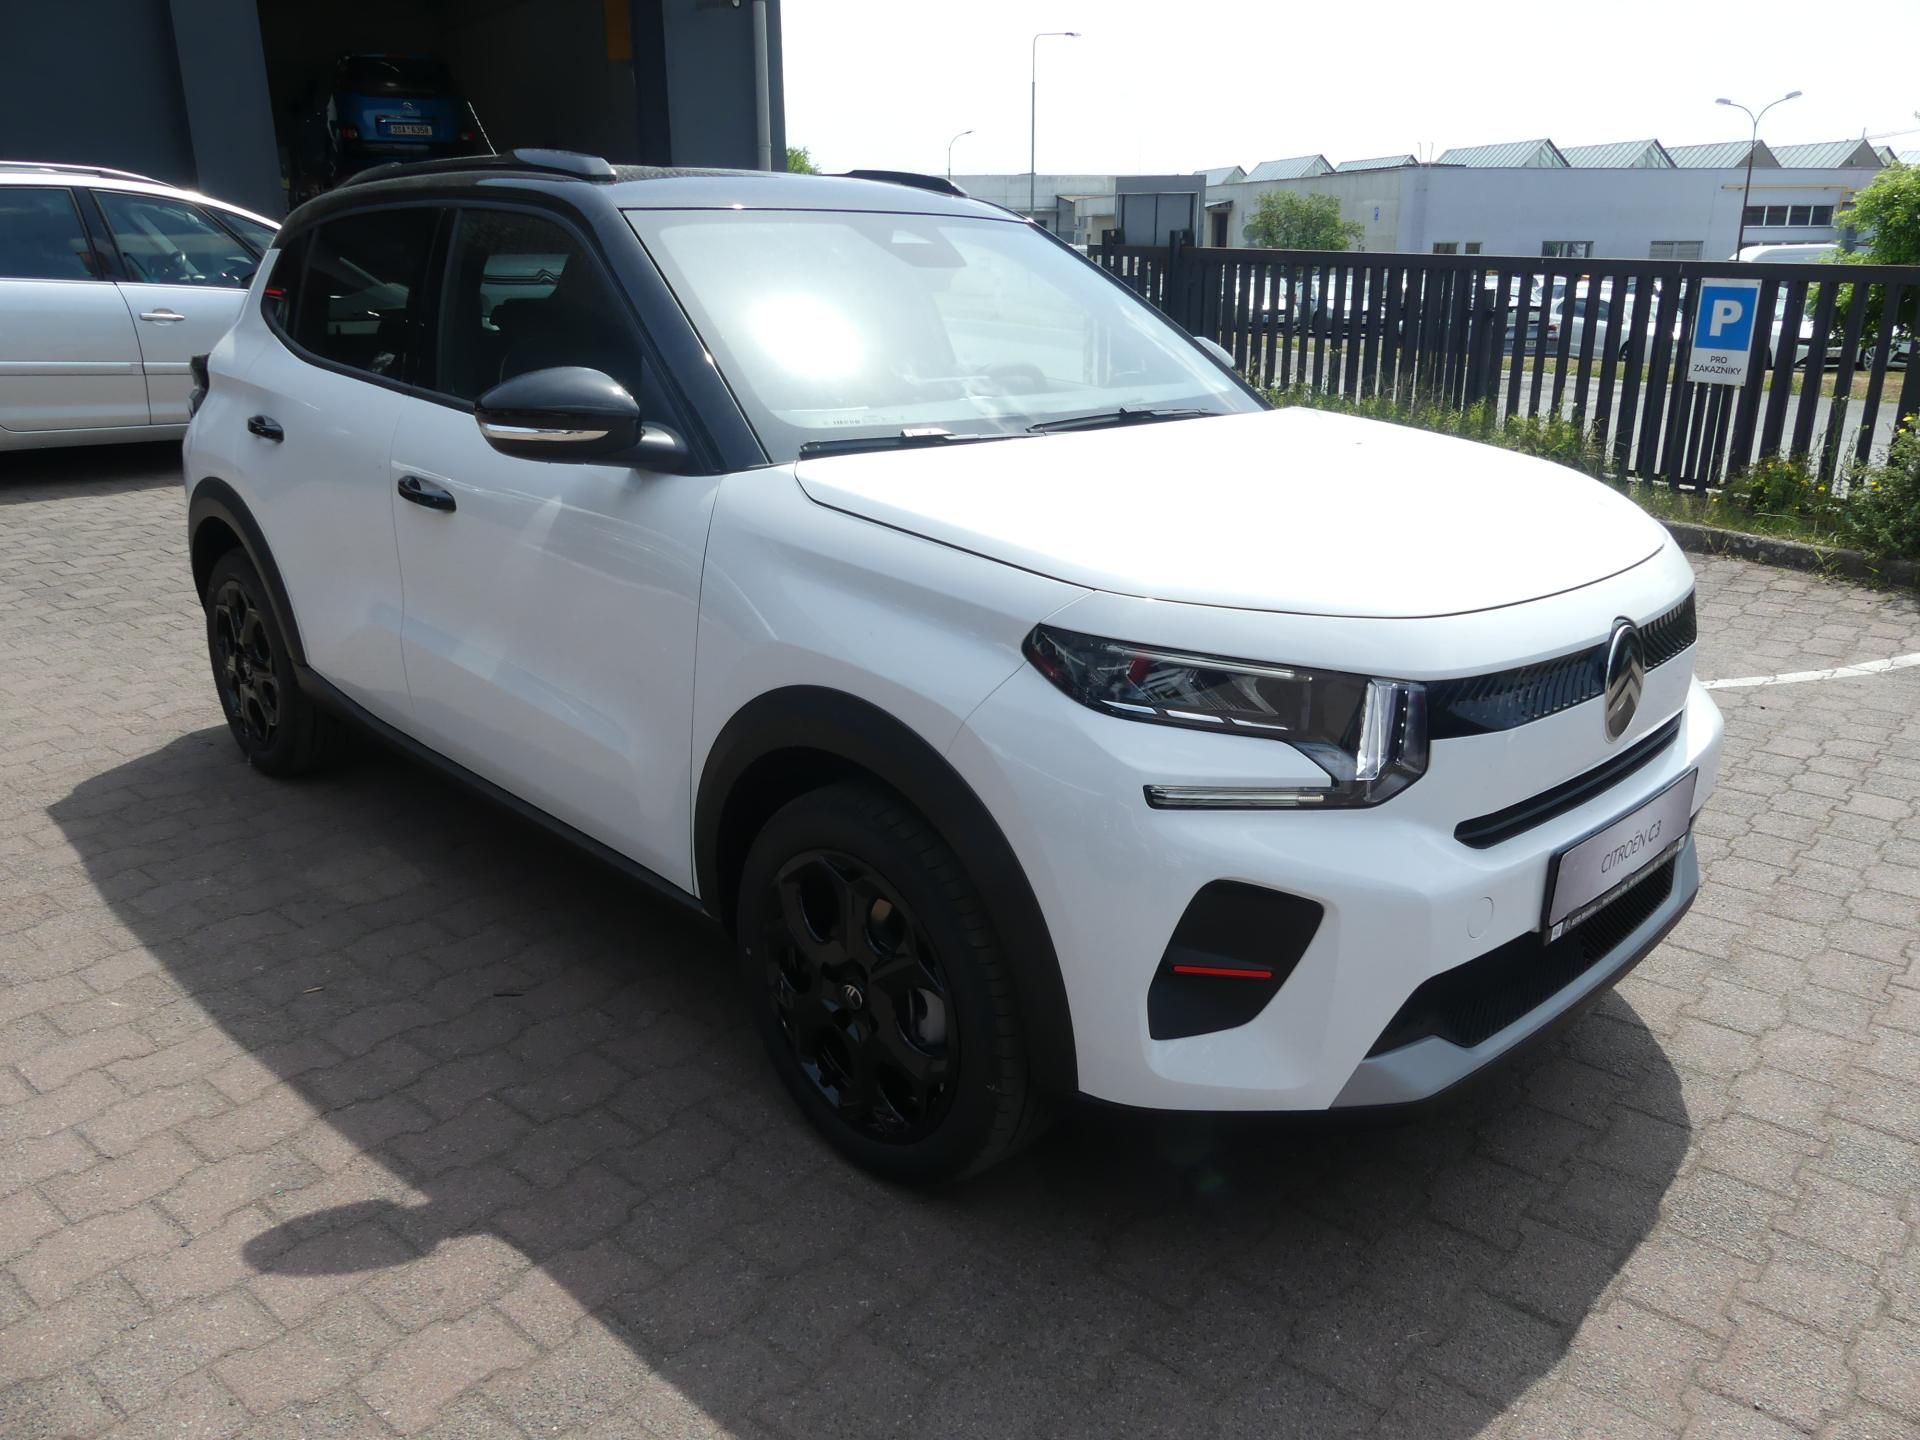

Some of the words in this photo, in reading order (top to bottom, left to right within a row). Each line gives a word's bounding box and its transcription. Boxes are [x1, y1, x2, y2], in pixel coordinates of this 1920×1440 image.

[1709, 299, 1743, 337] P
[1710, 355, 1728, 364] PRO
[1601, 831, 1648, 873] CITROËN
[1648, 819, 1662, 842] C3
